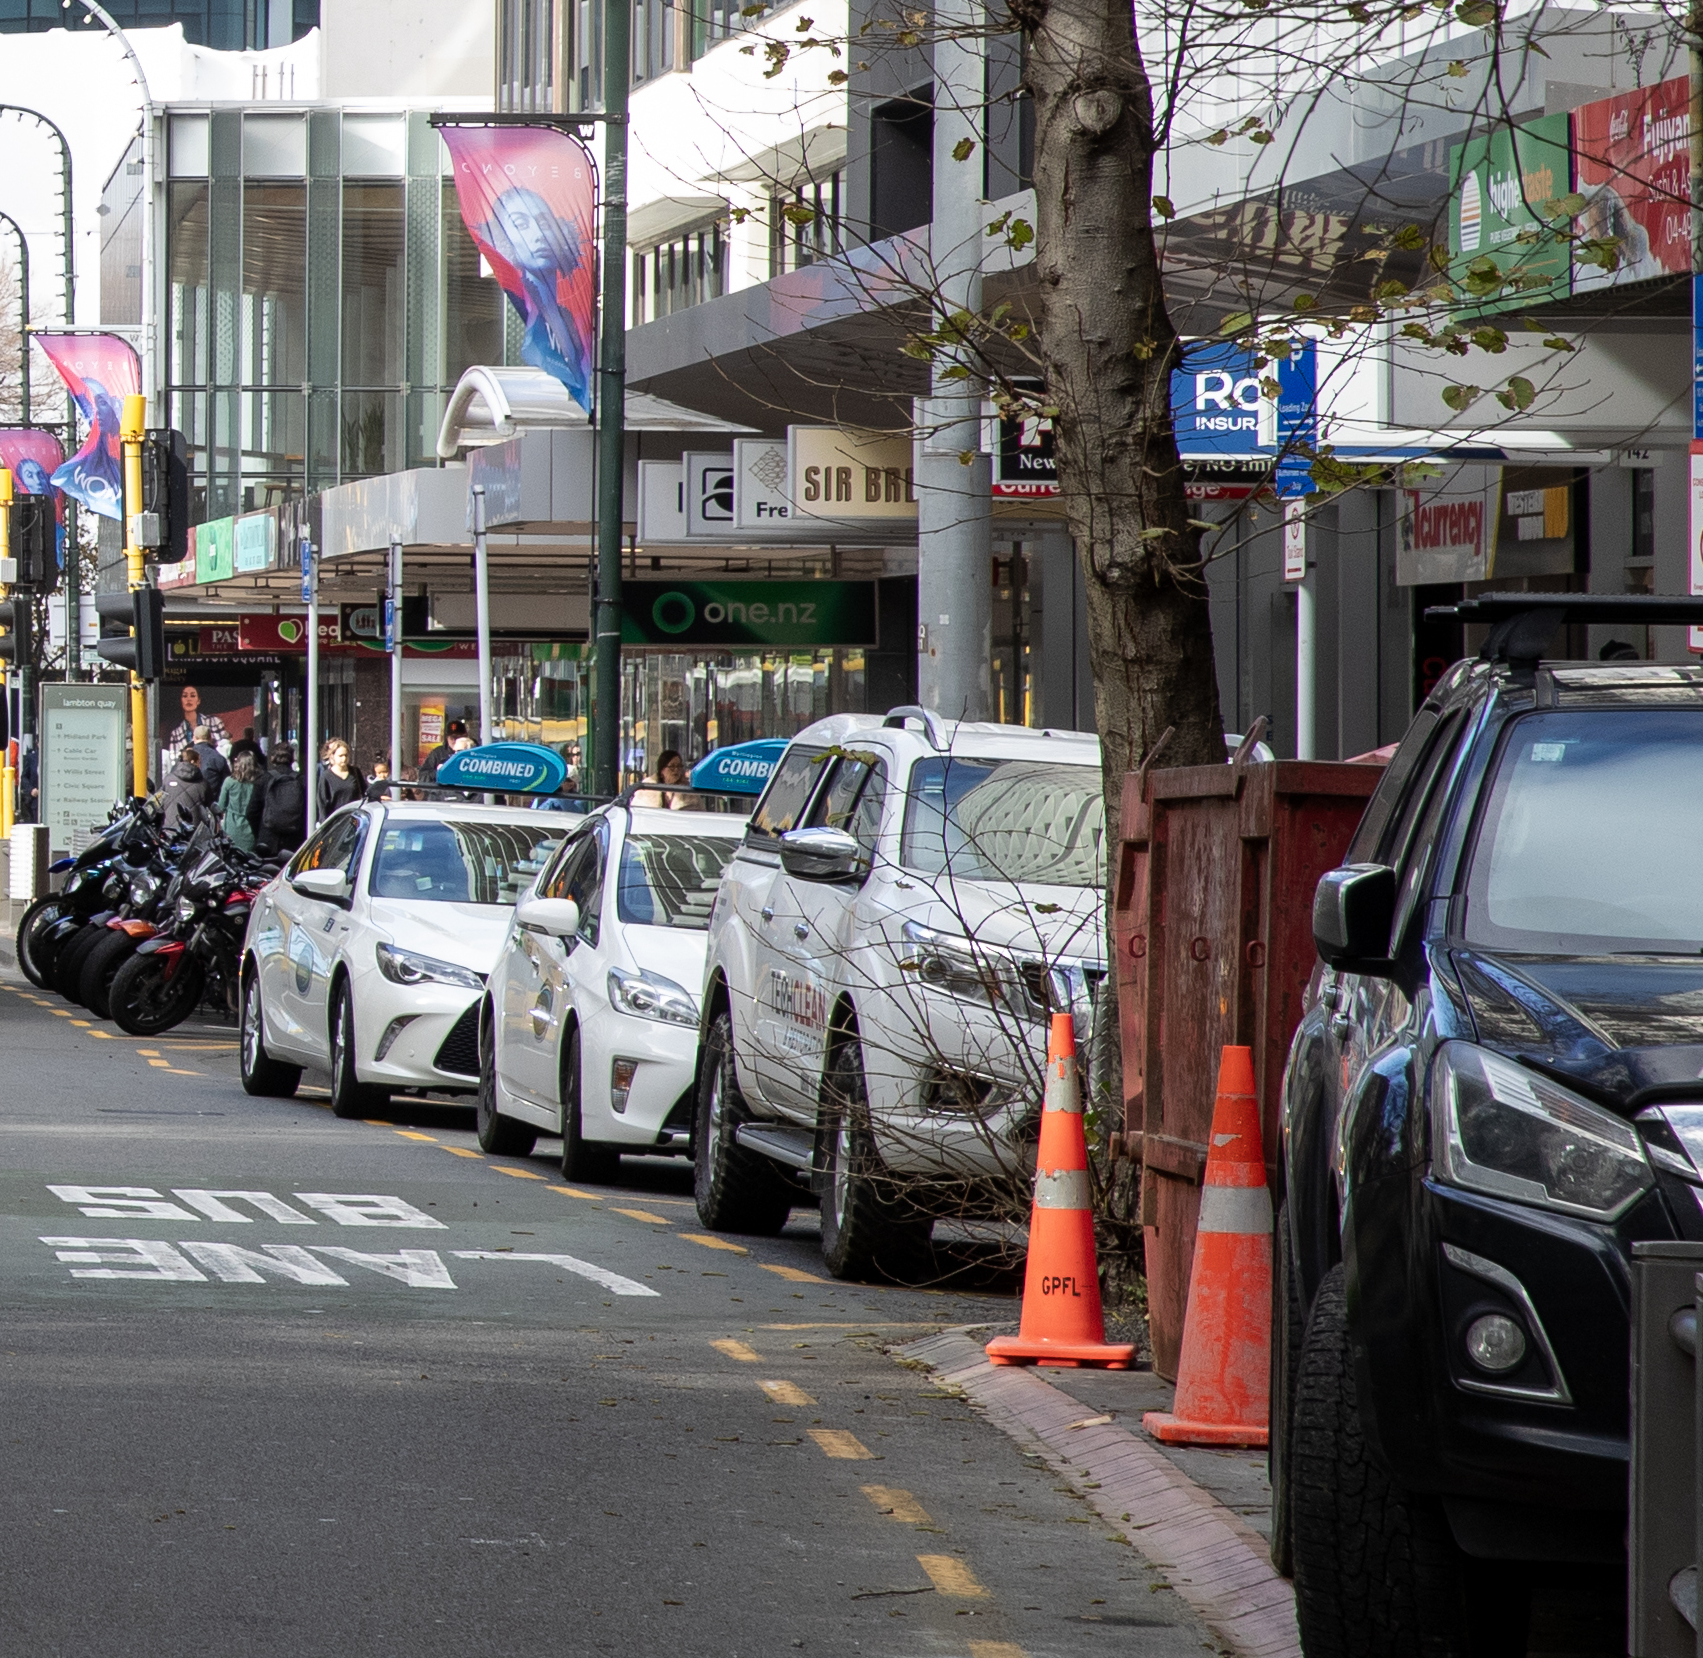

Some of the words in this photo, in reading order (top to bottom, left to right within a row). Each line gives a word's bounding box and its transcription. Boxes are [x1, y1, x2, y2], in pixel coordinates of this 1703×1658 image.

[804, 466, 853, 502] SIR
[703, 601, 817, 623] one.nz
[62, 698, 95, 708] lambton
[97, 699, 116, 709] quay
[459, 757, 535, 778] COMBINED
[45, 1185, 450, 1230] BUS
[37, 1236, 662, 1297] LANE
[1042, 1275, 1081, 1297] GPFL
